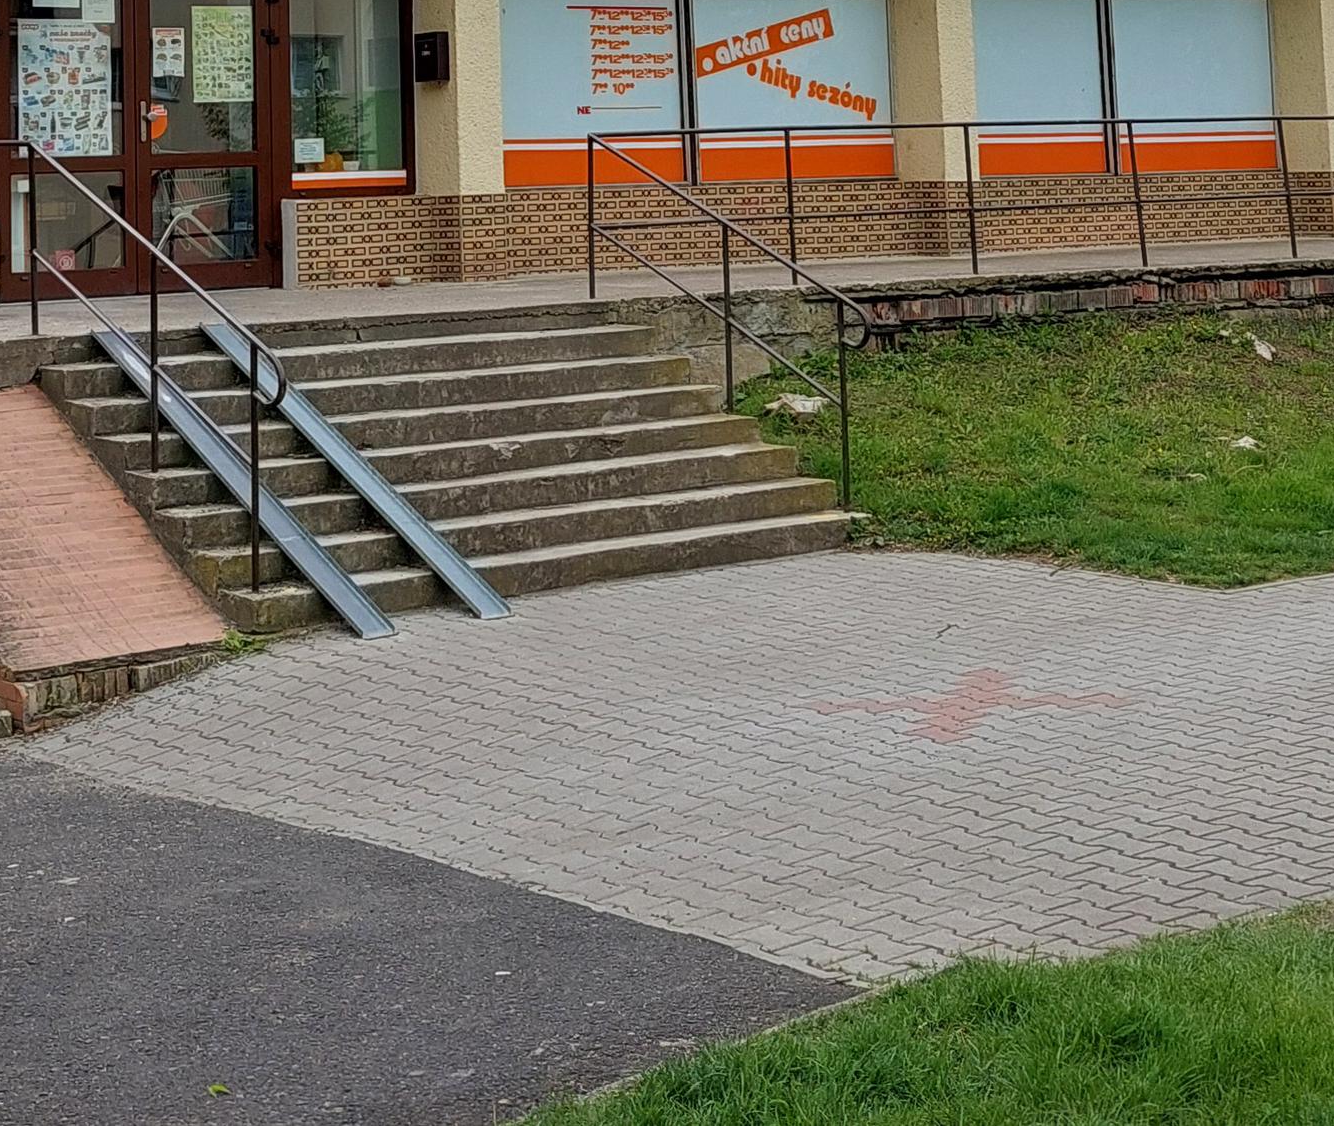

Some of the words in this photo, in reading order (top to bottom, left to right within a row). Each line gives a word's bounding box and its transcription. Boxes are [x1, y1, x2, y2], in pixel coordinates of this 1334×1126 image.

[715, 26, 770, 65] akční
[779, 16, 826, 40] ceny
[576, 105, 592, 115] NE
[760, 58, 802, 99] hity
[807, 81, 877, 121] sezóny
